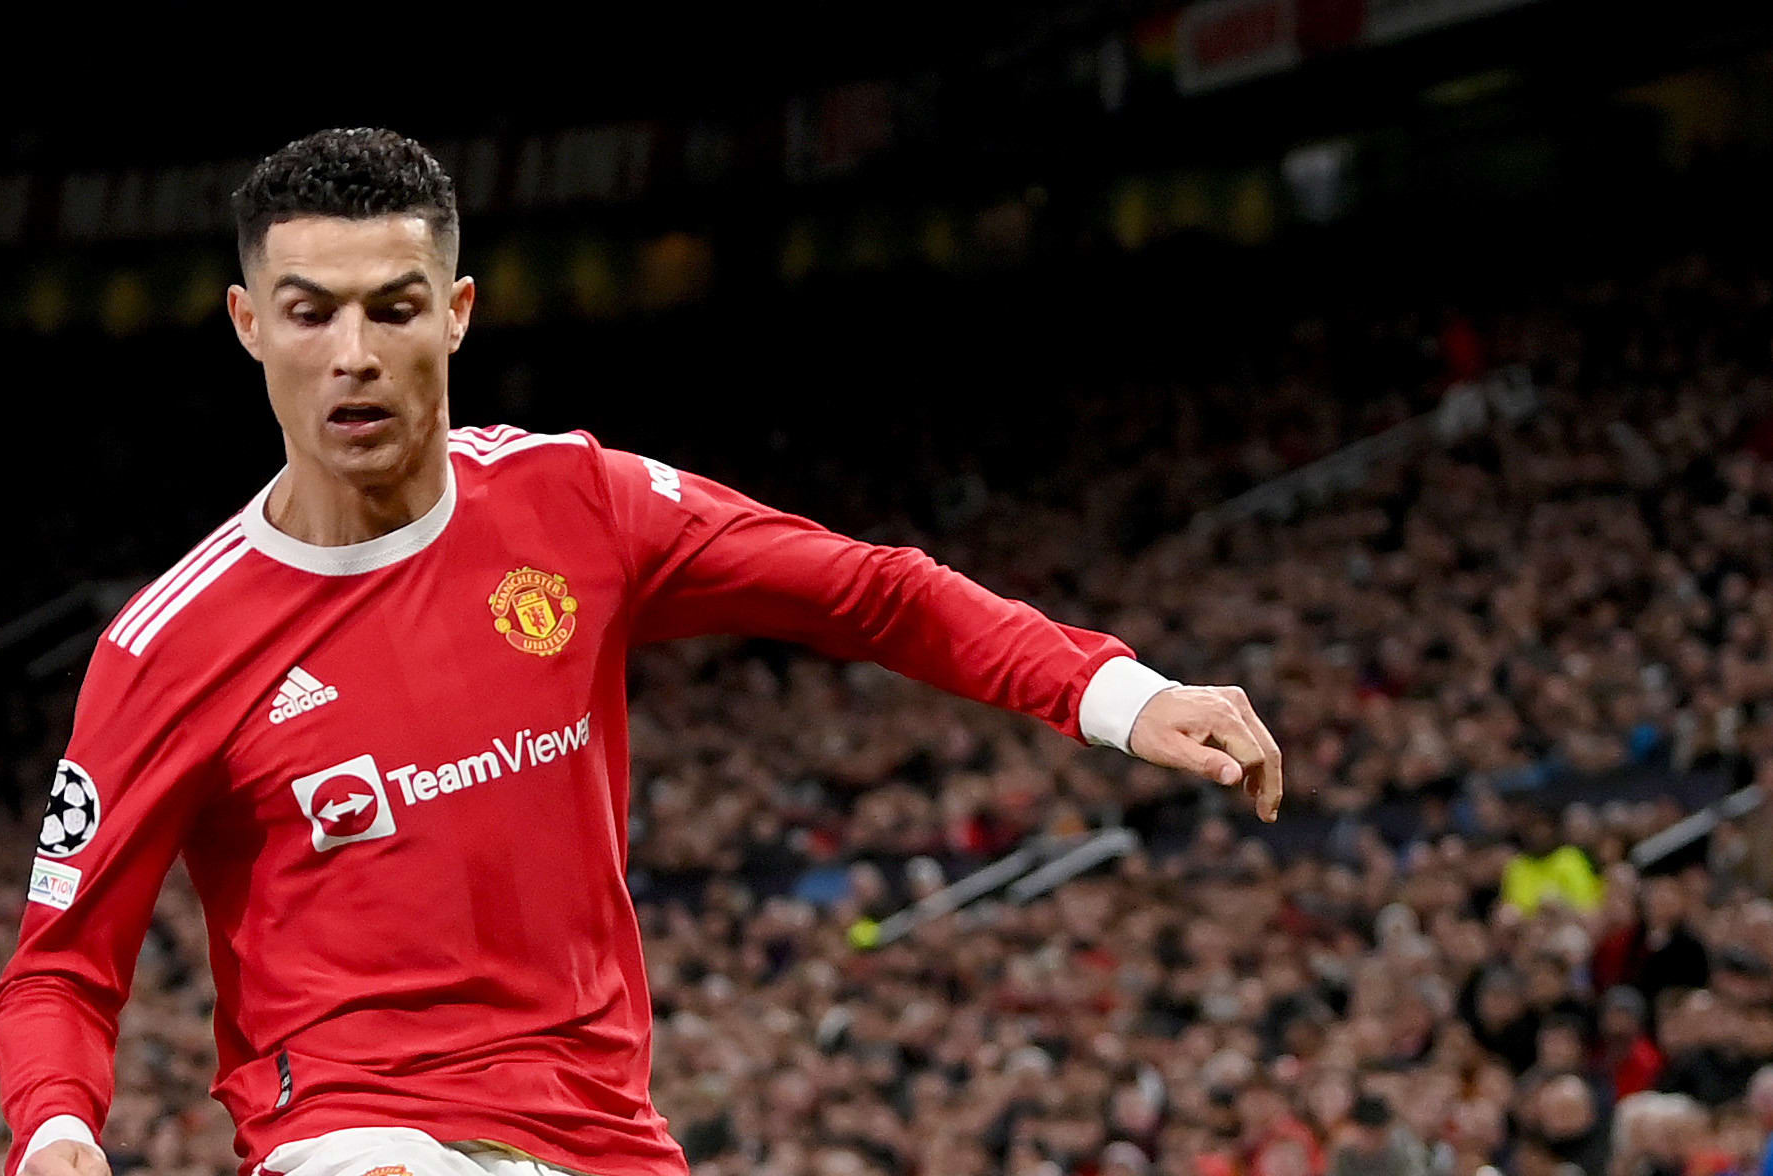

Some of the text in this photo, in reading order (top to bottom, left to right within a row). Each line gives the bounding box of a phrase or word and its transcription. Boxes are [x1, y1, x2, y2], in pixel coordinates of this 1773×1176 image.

[495, 573, 562, 611] MANCHESTER
[522, 627, 569, 650] UNITED
[269, 684, 339, 724] adidas
